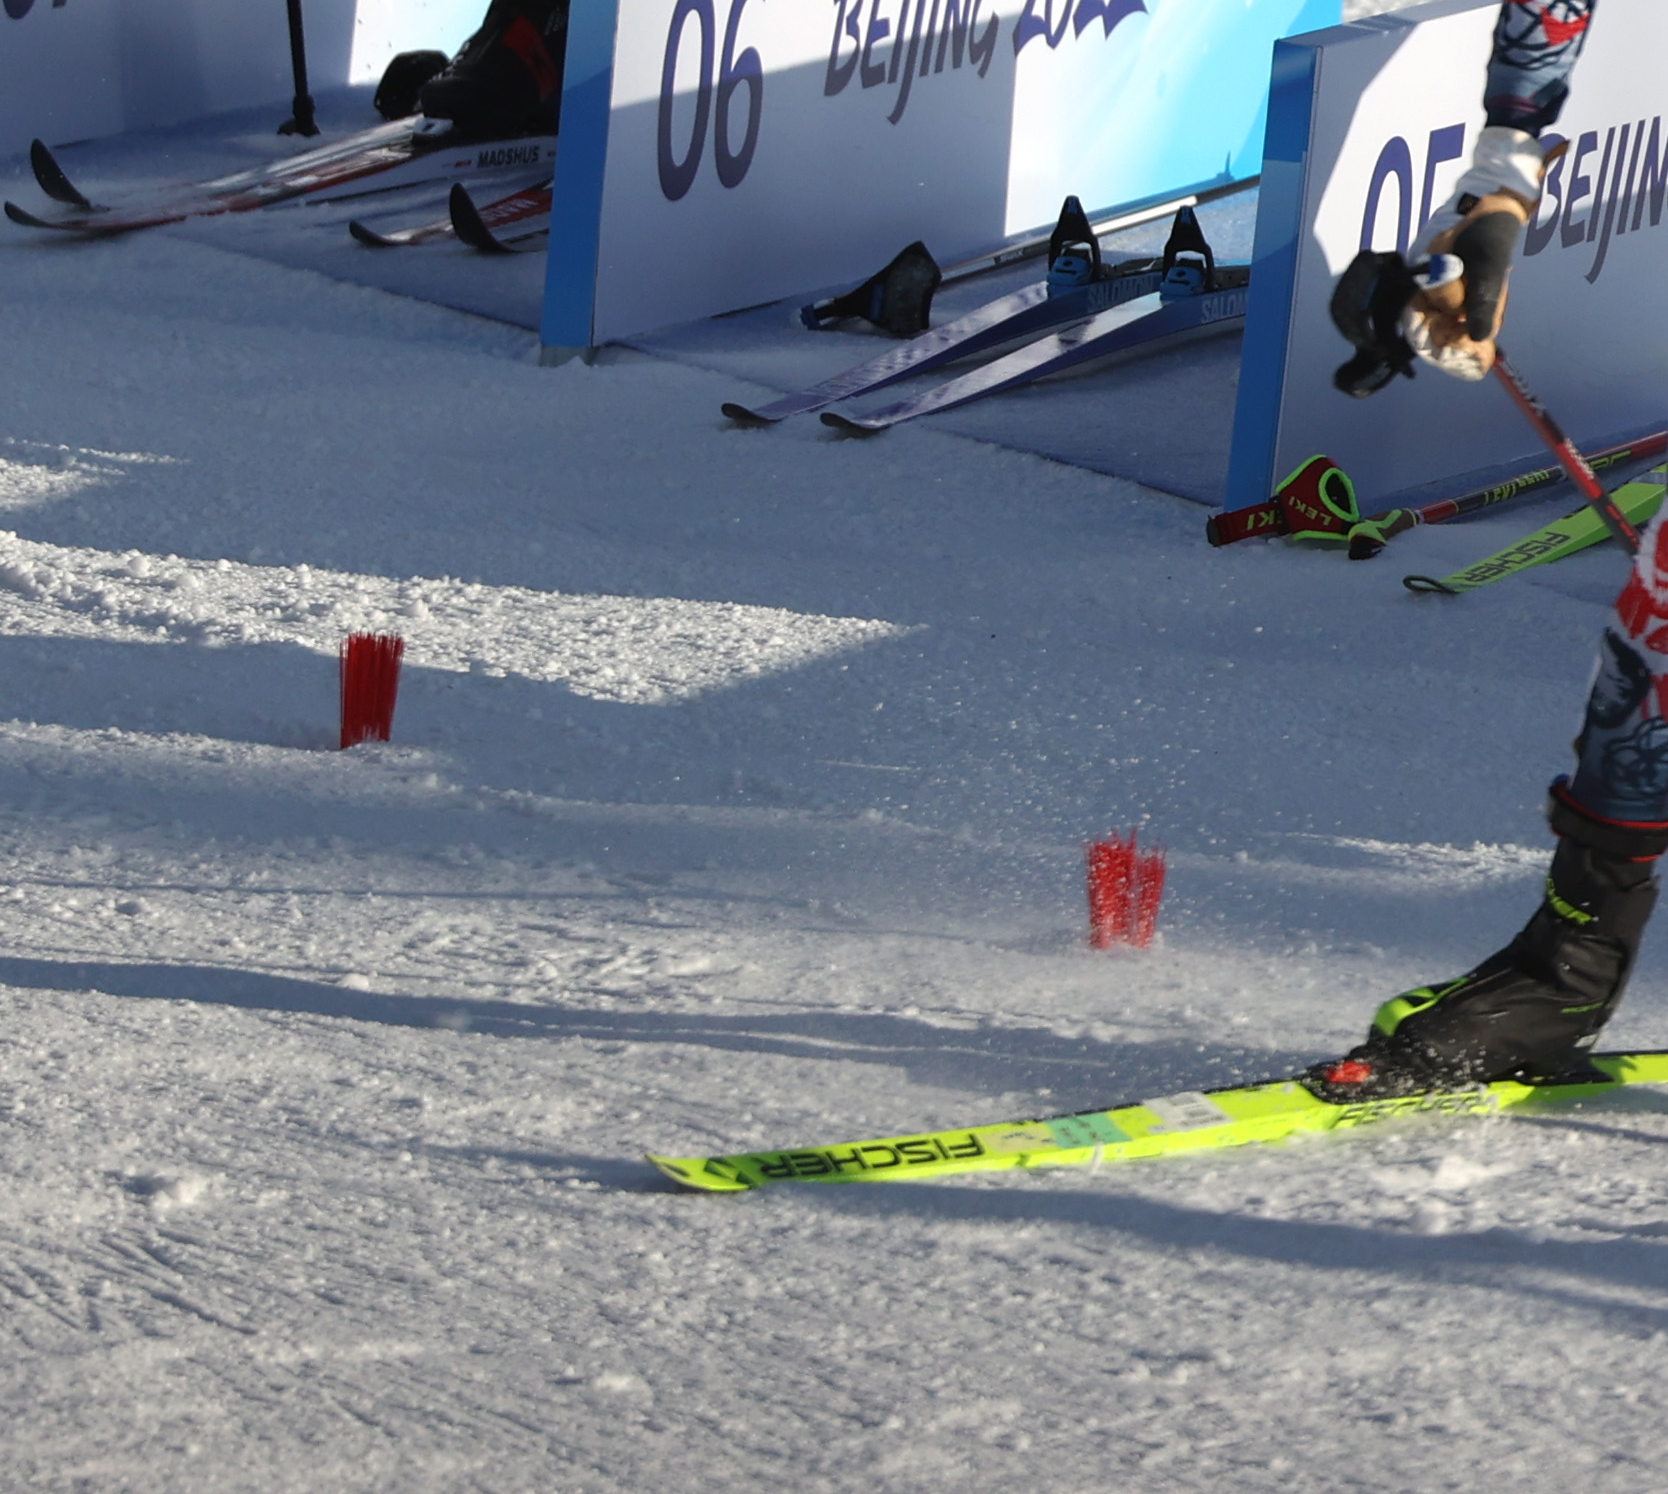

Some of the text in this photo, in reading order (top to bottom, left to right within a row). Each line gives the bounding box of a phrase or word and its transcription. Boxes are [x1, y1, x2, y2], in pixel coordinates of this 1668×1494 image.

[476, 145, 541, 169] MADSHUS
[1201, 290, 1249, 324] SALOM
[1288, 495, 1333, 526] LEKI
[1451, 531, 1571, 585] FISCHER
[764, 1132, 984, 1179] FISCHER
